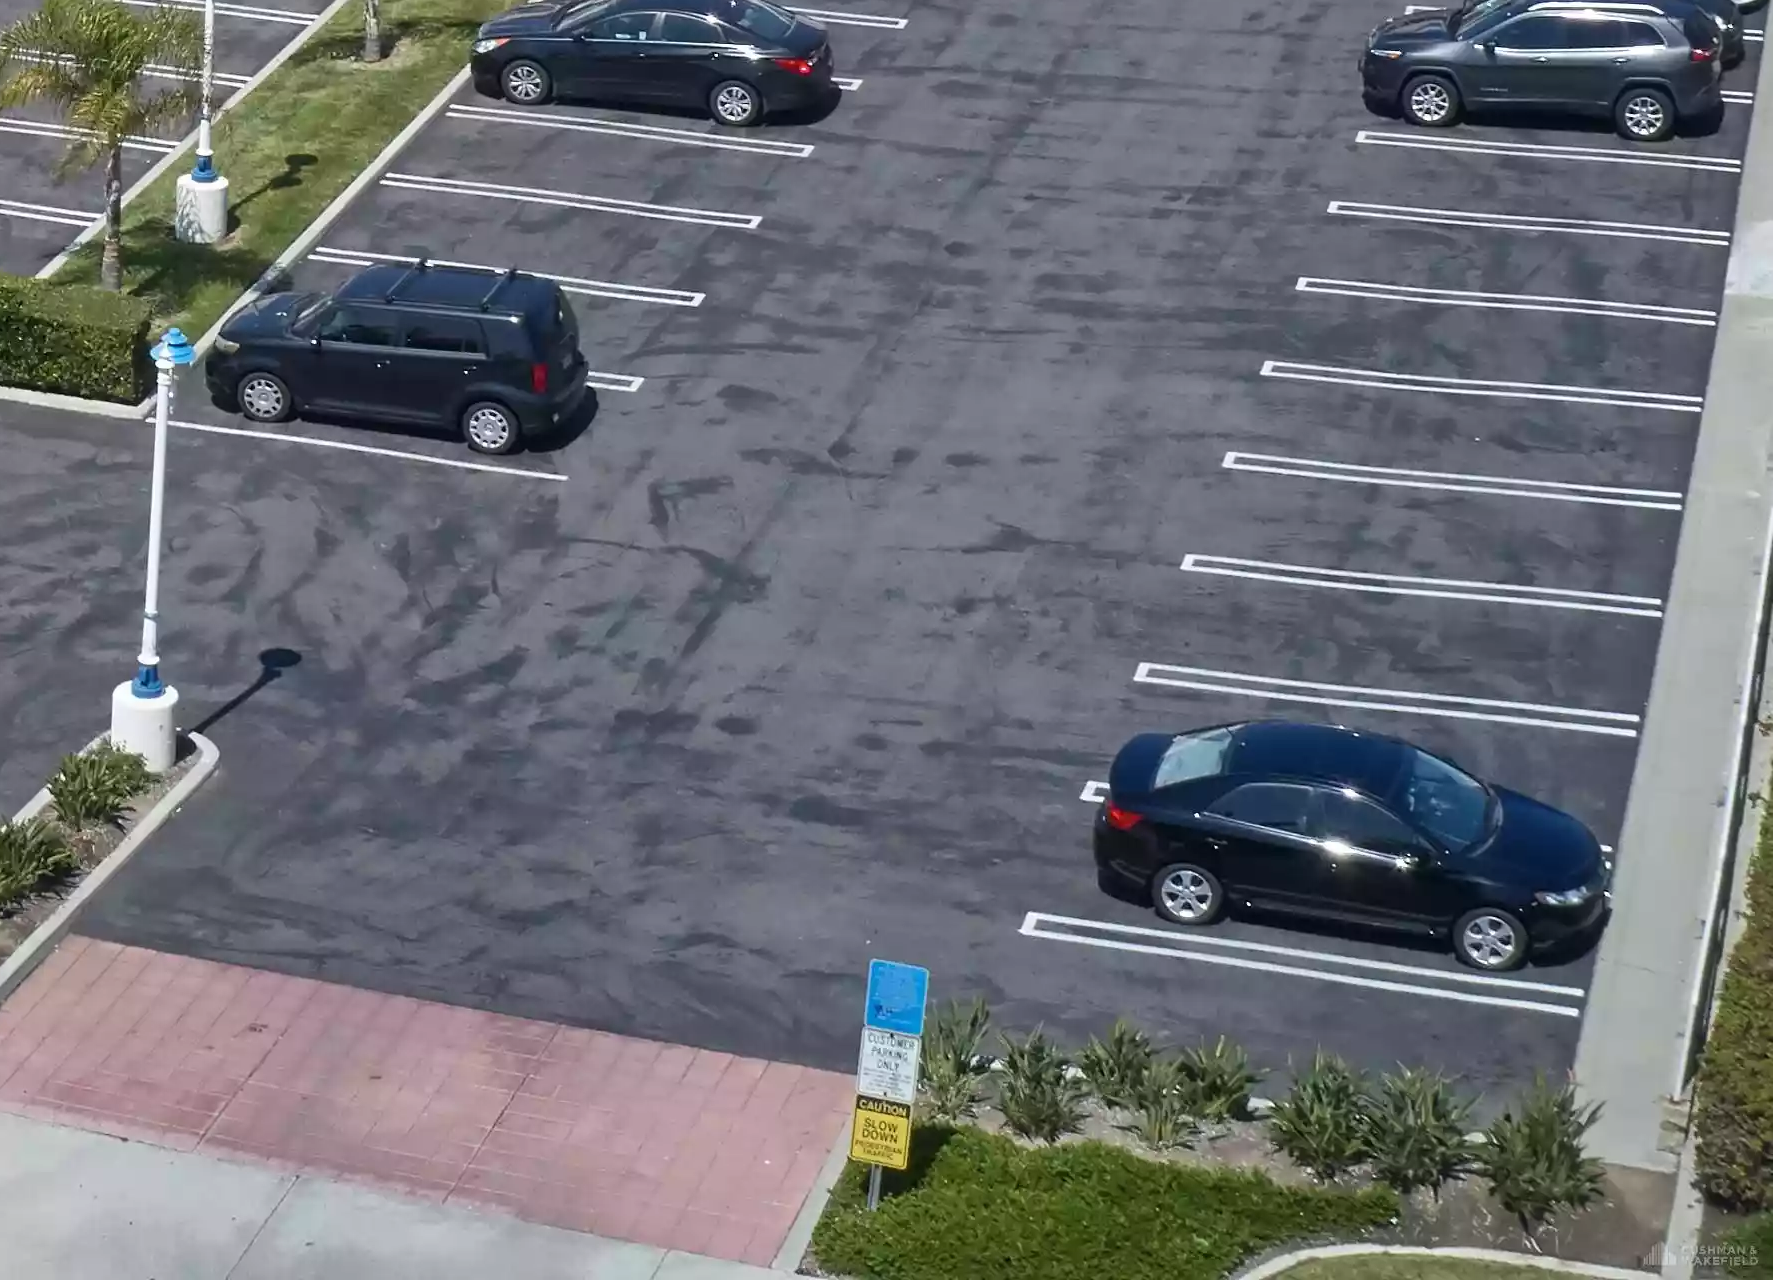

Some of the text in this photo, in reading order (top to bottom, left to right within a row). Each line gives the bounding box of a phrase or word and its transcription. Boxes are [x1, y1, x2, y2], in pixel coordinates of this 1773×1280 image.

[868, 1032, 915, 1049] CUSTOMER
[871, 1046, 908, 1061] PARKING
[877, 1060, 900, 1073] ONLY
[859, 1099, 907, 1116] CAUTION
[864, 1117, 899, 1133] SLOW
[862, 1128, 898, 1144] DOWN
